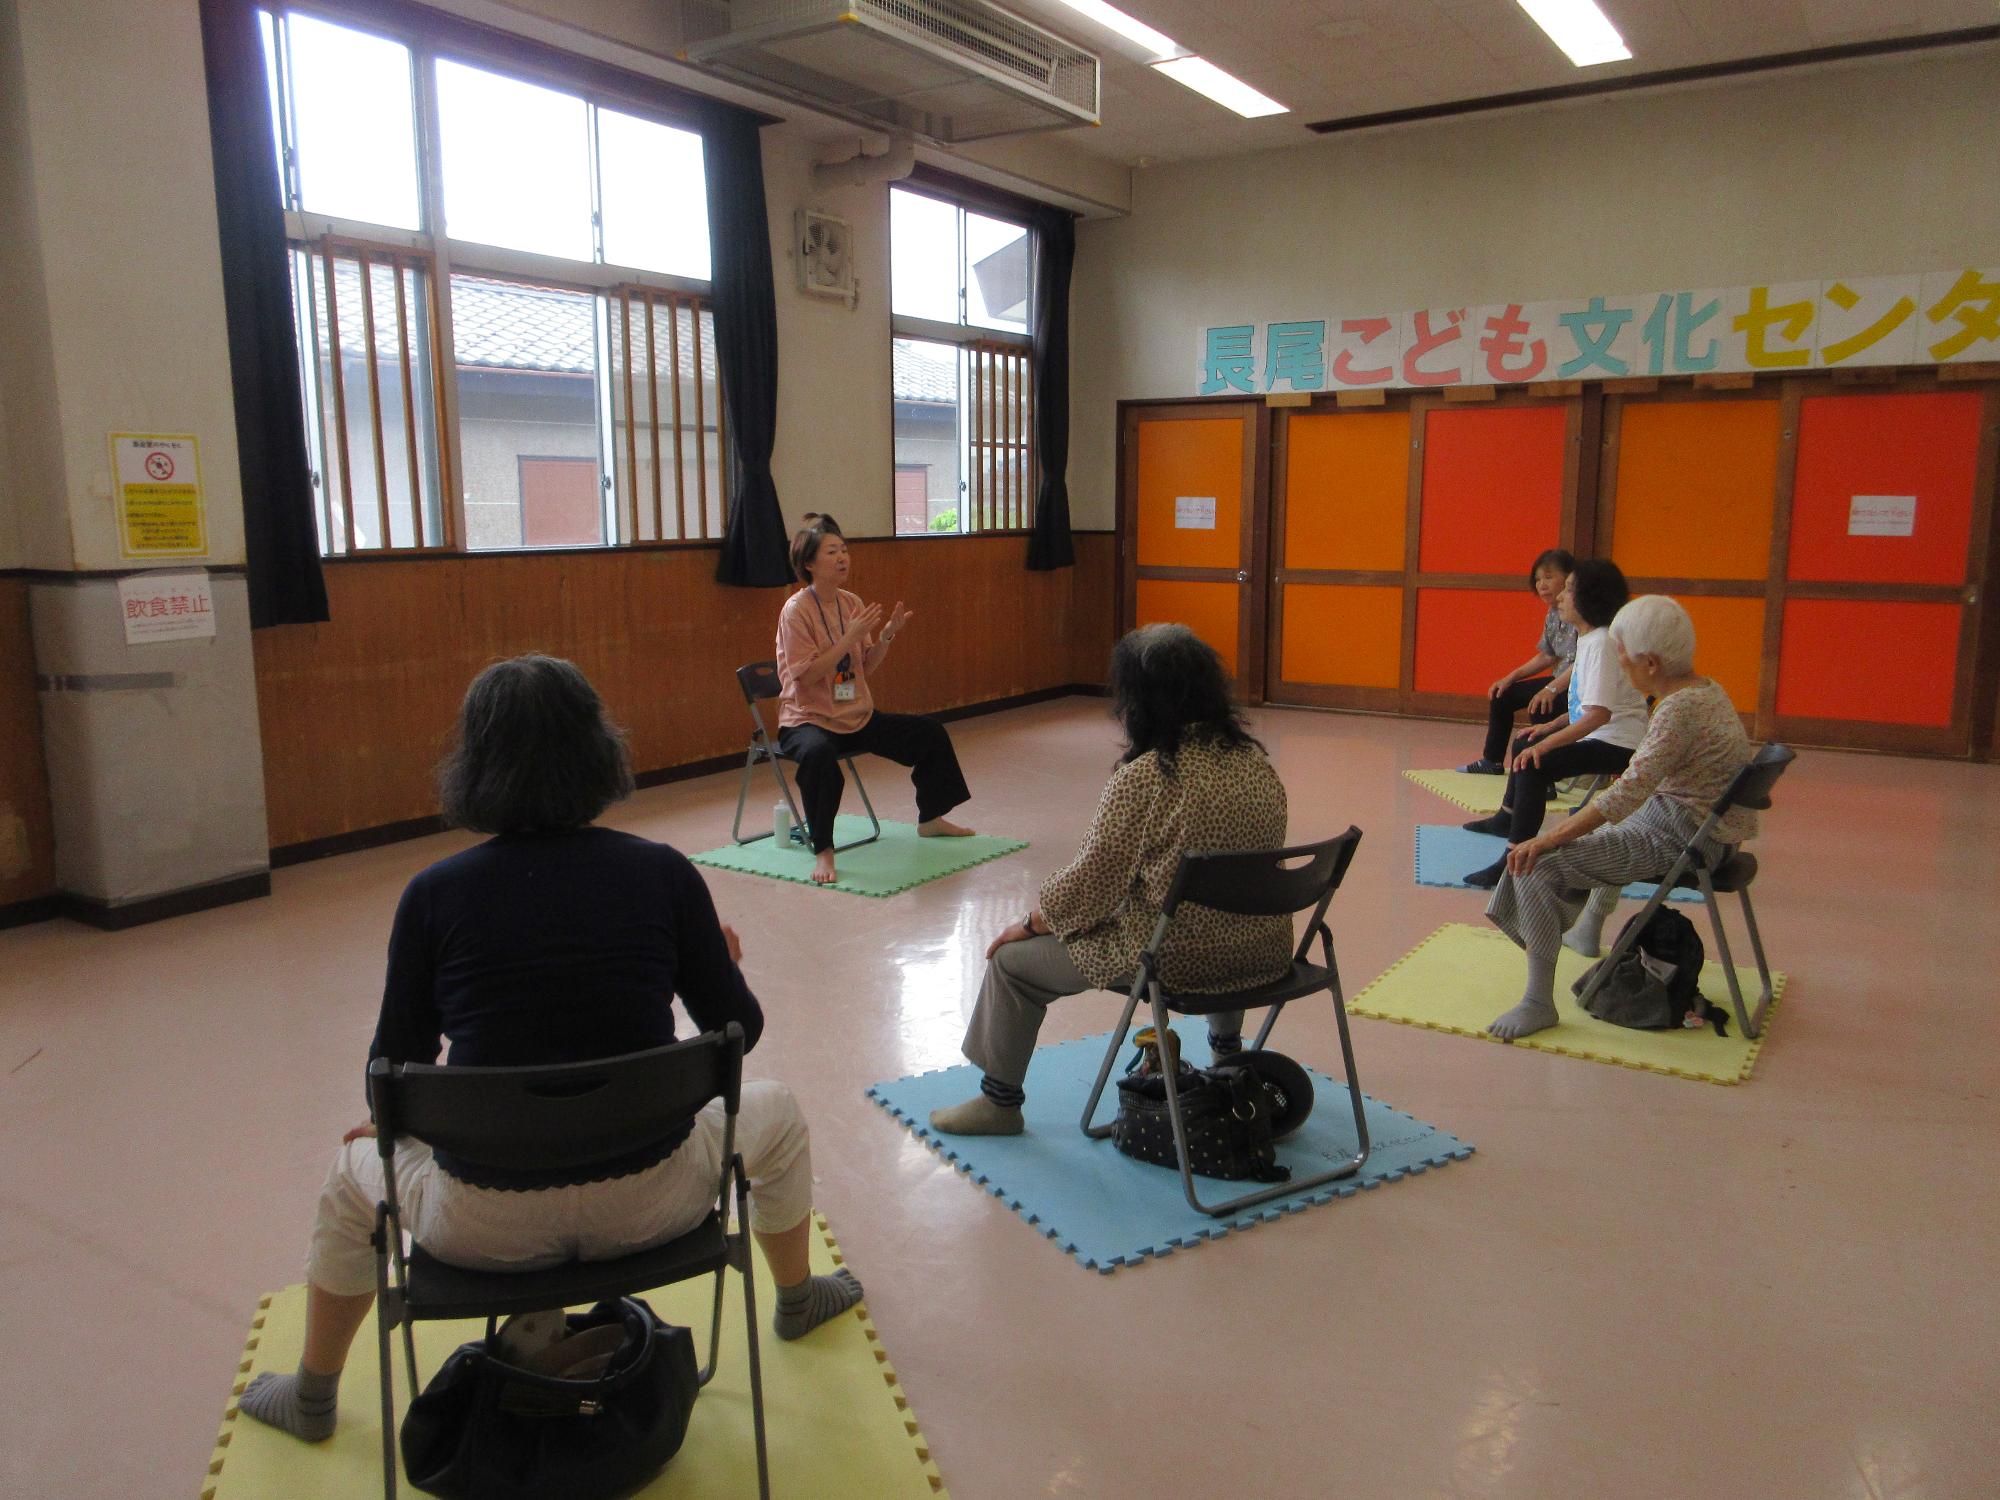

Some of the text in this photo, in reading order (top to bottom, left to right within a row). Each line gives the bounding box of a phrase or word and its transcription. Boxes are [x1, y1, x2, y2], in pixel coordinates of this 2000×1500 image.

[1201, 269, 2000, 395] 長尾こども文化センタ
[126, 594, 210, 619] 飲食禁止
